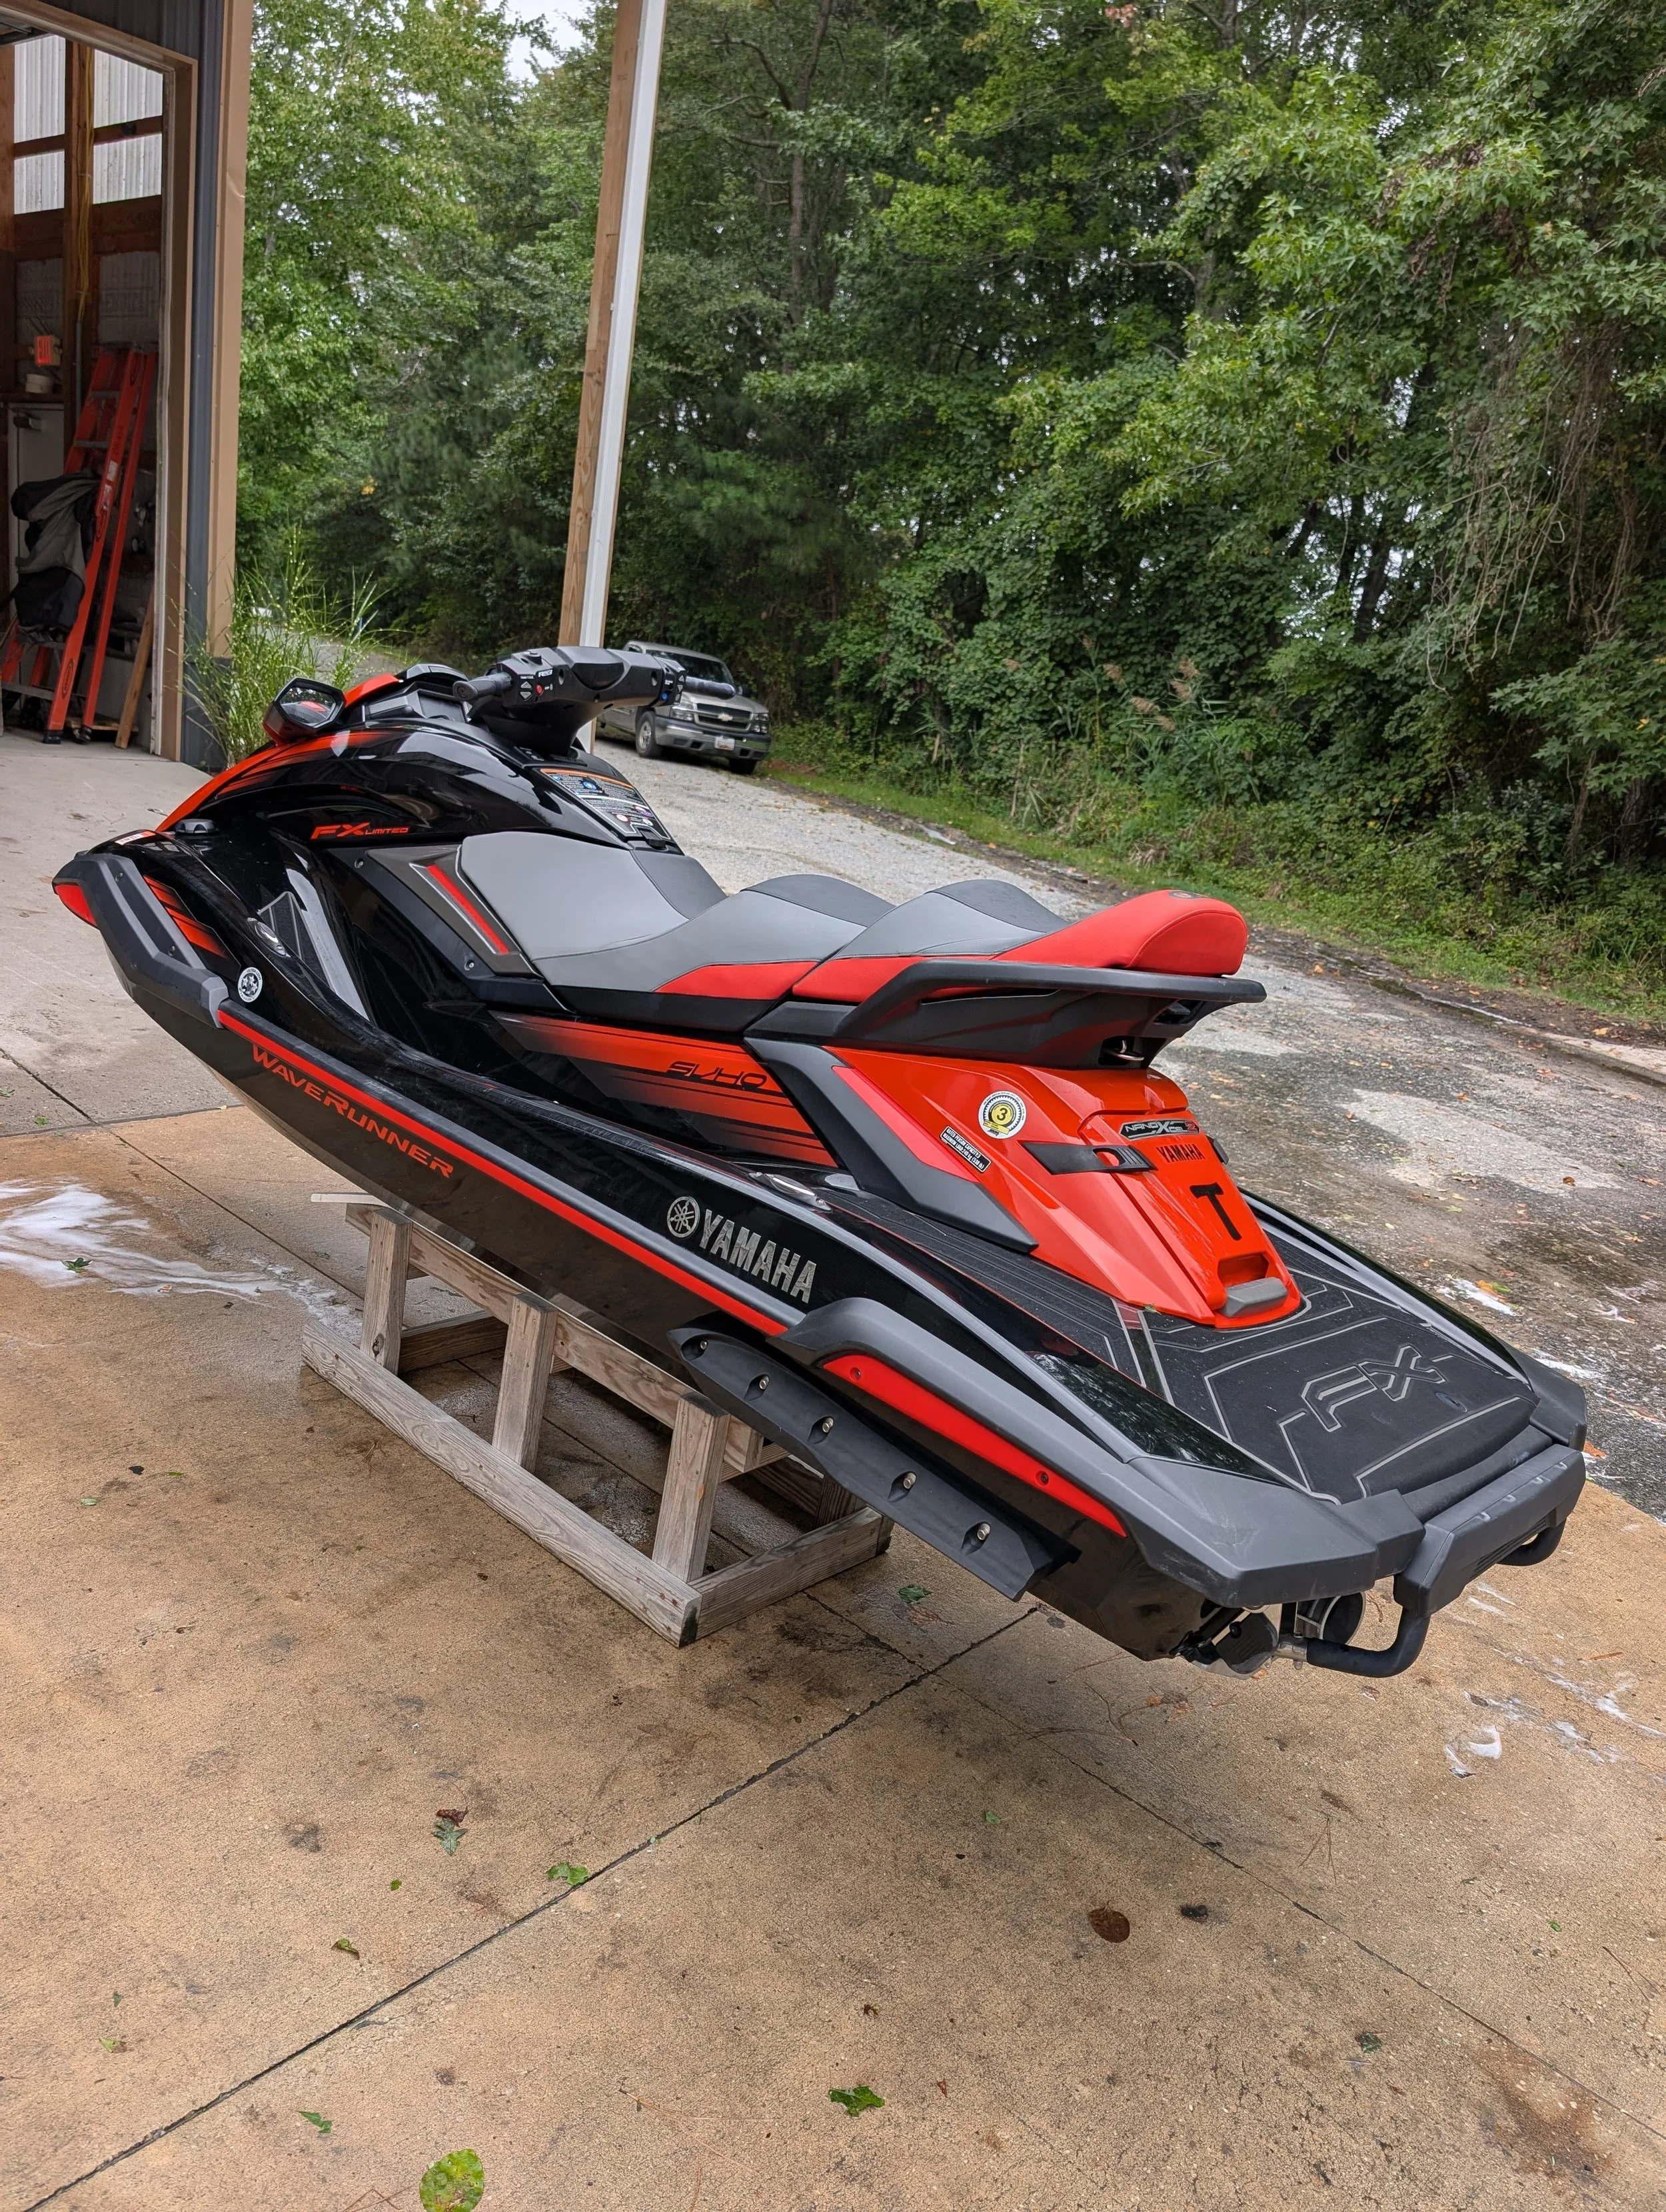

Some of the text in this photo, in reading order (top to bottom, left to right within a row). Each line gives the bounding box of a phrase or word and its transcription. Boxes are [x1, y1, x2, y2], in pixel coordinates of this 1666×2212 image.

[311, 822, 410, 840] FX LIMITED
[666, 1061, 767, 1088] SVHO
[251, 1043, 454, 1179] WAVERUNNER
[997, 1107, 1008, 1121] 3
[954, 1135, 966, 1146] PERSON
[1156, 1144, 1206, 1163] YAMAHA
[1189, 1181, 1242, 1241] T
[700, 1209, 817, 1304] YAMAHA
[1301, 1345, 1446, 1432] FX
